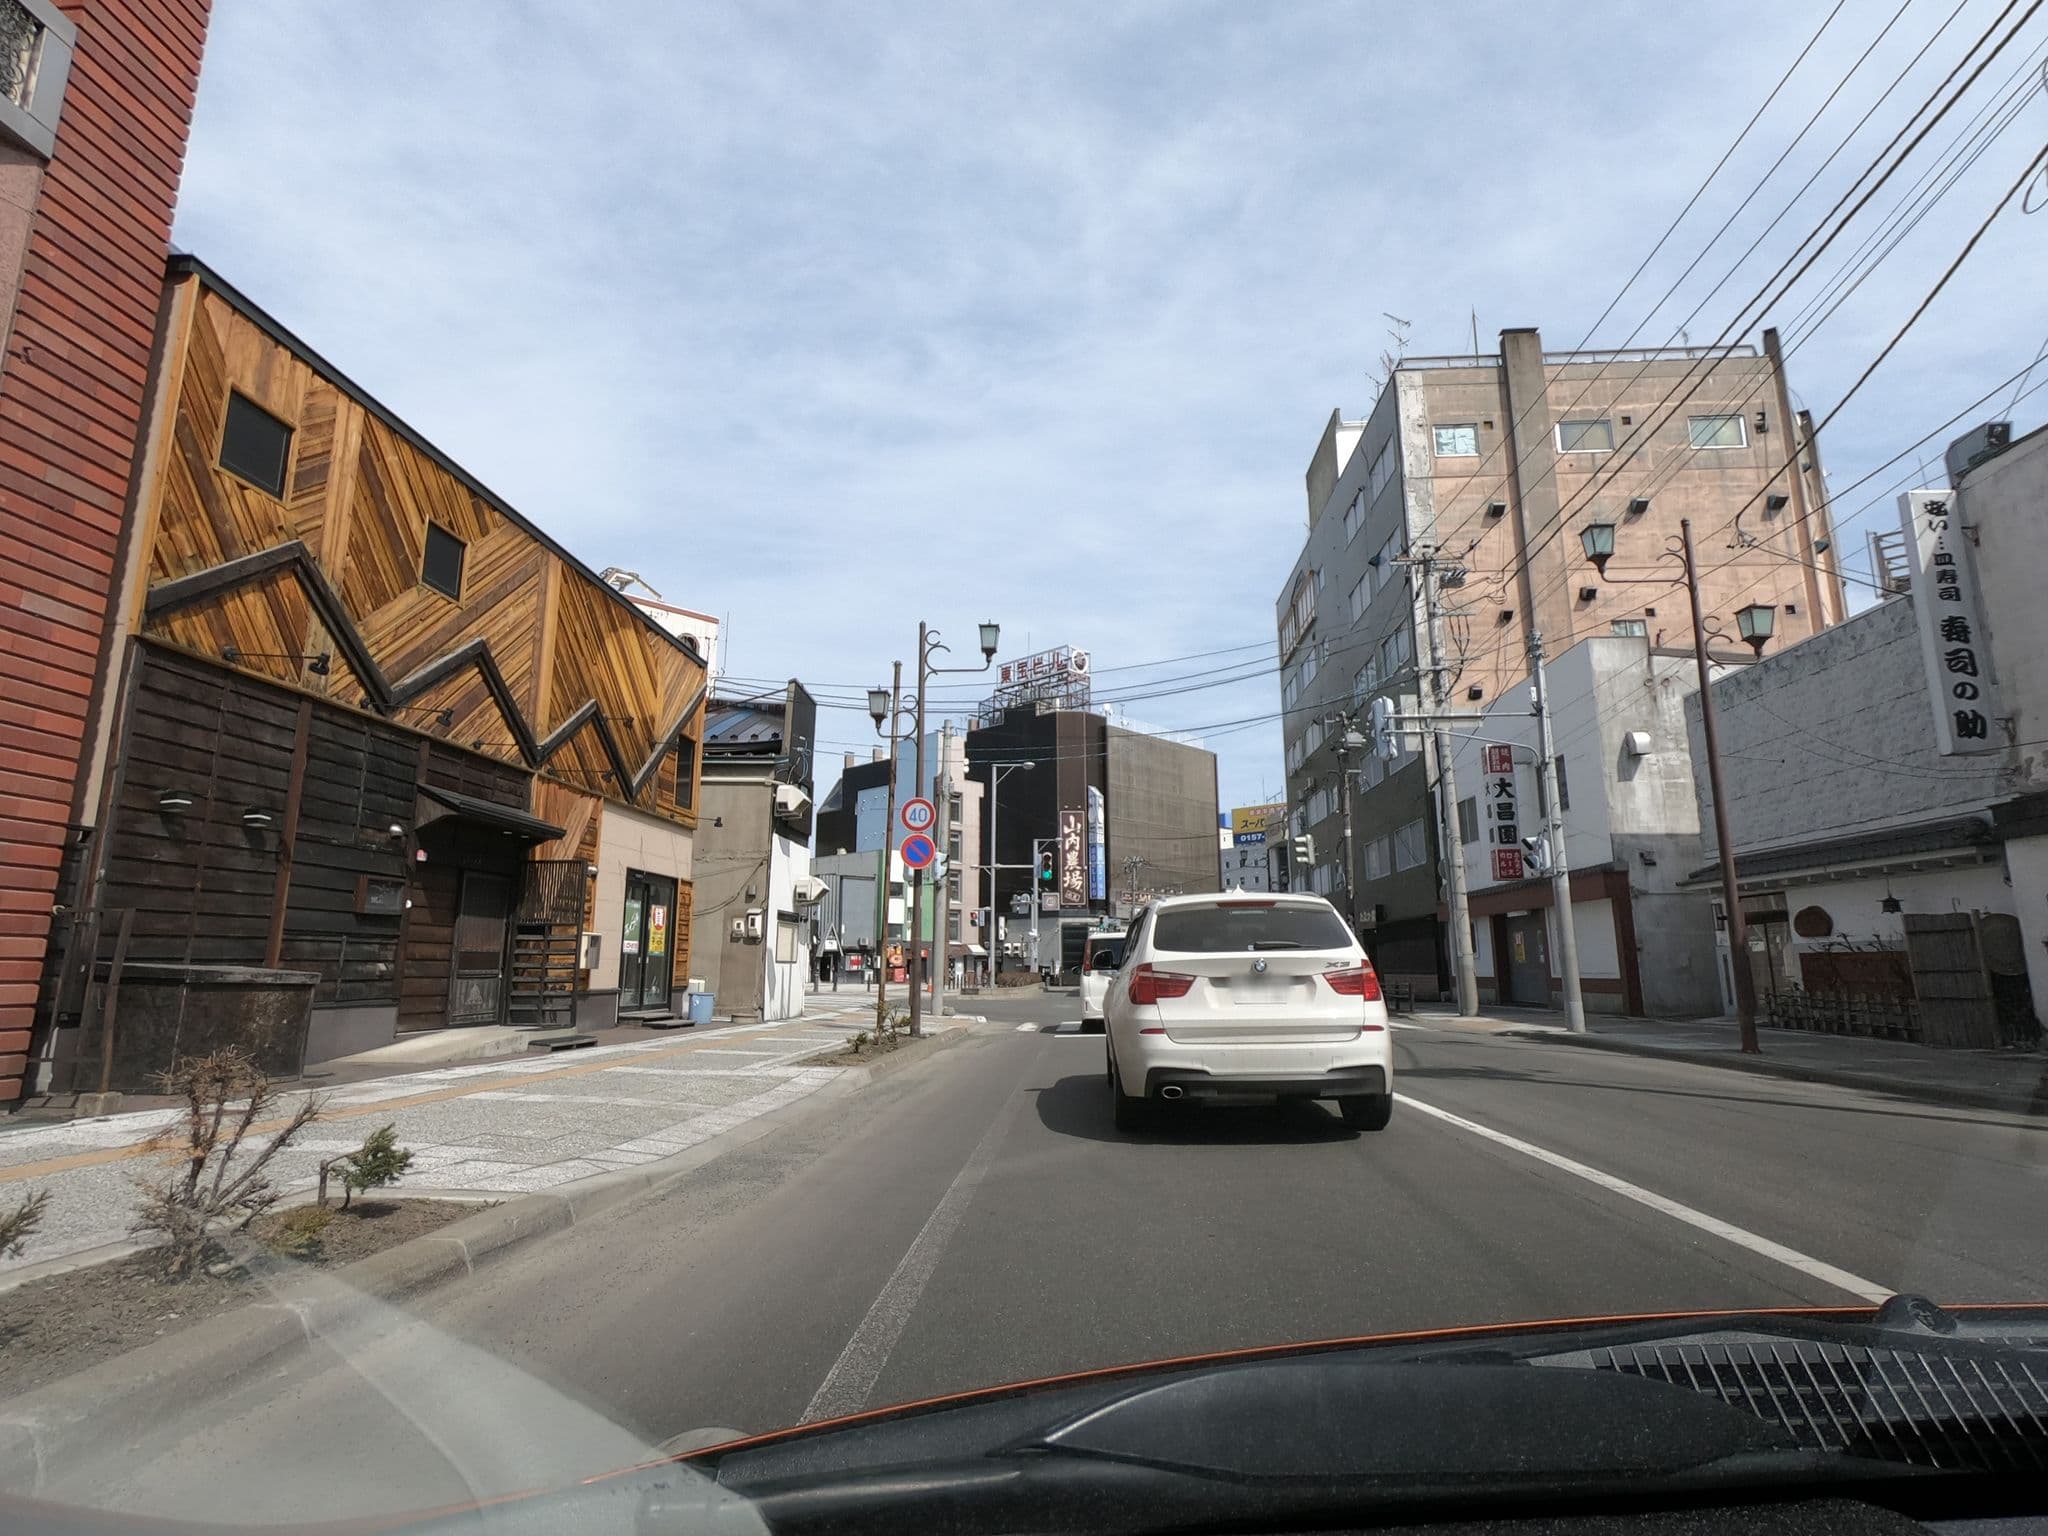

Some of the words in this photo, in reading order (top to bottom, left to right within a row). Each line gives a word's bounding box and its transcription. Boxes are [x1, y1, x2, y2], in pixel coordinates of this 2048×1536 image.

[909, 808, 928, 822] 40
[1063, 815, 1083, 891] 山内農場
